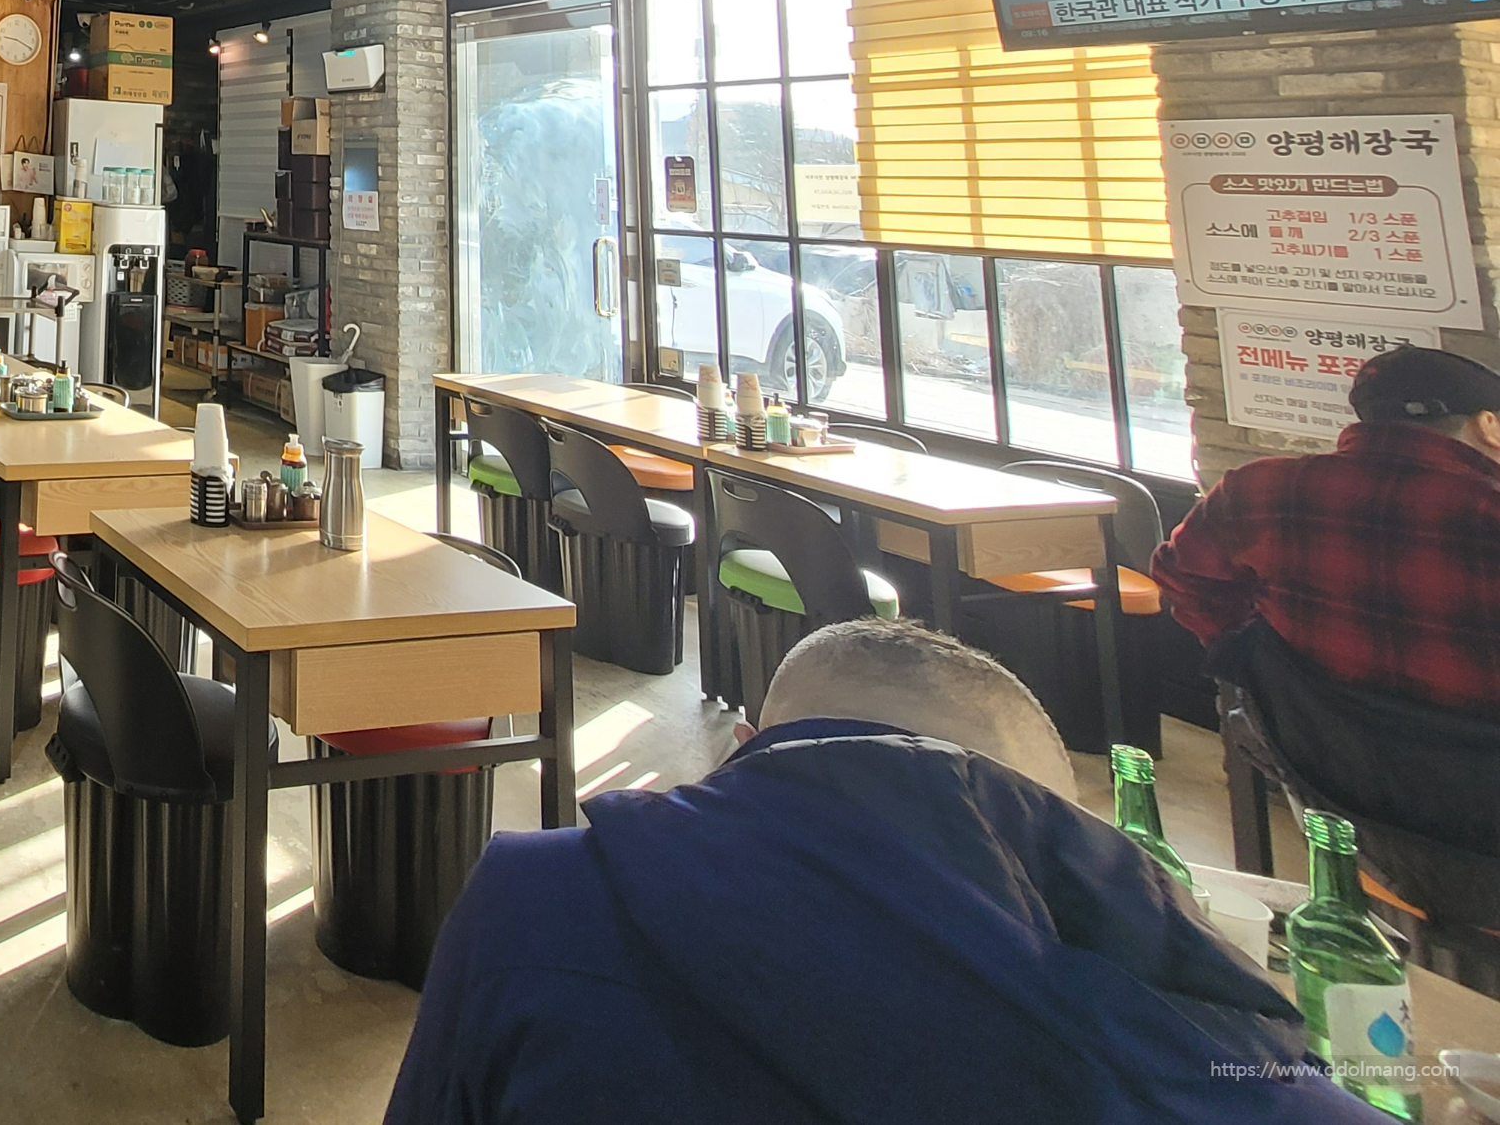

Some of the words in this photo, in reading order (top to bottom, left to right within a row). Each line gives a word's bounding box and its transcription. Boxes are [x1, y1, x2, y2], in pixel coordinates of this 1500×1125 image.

[1266, 129, 1440, 157] 양평해장국
[1222, 178, 1255, 191] 소스
[1257, 178, 1308, 192] 맛있게
[1311, 179, 1384, 193] 만드는법
[1266, 209, 1328, 224] 고추절임
[1348, 212, 1378, 225] 1/3
[1383, 213, 1418, 227] 스푼
[1205, 222, 1259, 239] 소스에
[1348, 229, 1381, 242] 2/3
[1385, 230, 1421, 244] 스푼
[1374, 247, 1382, 260] 1
[1388, 248, 1423, 263] 스푼
[1293, 266, 1316, 277] 고기
[1335, 269, 1360, 280] 선지
[1206, 274, 1238, 284] 소스에
[1266, 277, 1300, 288] 드신후
[1383, 285, 1438, 298] 드십시오
[1236, 345, 1309, 372] 전메뉴
